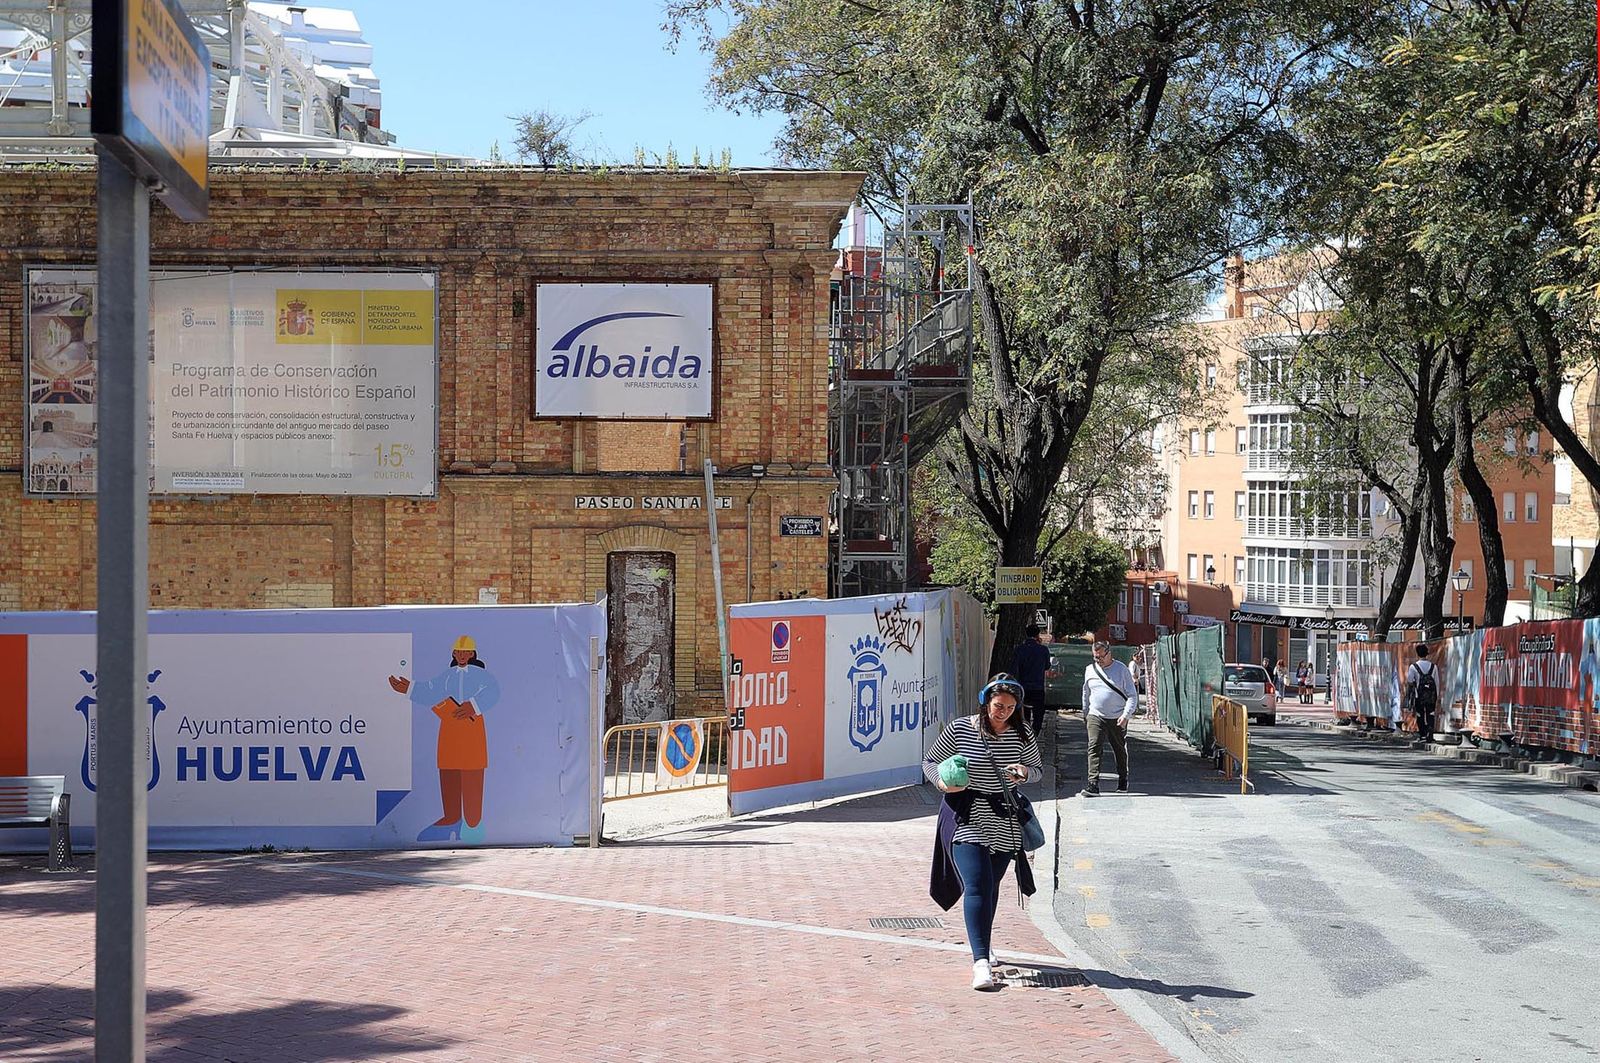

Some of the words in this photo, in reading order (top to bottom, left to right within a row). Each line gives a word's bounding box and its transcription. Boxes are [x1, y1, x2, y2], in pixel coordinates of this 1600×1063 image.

[547, 345, 701, 378] albaida
[172, 363, 246, 380] Programa
[250, 363, 269, 377] de
[274, 363, 378, 378] Conservación
[171, 383, 194, 398] del
[199, 383, 279, 398] Patrimonio
[284, 384, 350, 398] Histórico
[355, 385, 416, 402] Español
[172, 410, 203, 420] Proyecto
[205, 411, 215, 419] de
[216, 411, 268, 420] conservación,
[269, 411, 320, 420] consolidación
[364, 412, 409, 420] constructiva
[410, 413, 416, 422] y
[171, 421, 182, 429] de
[183, 421, 230, 429] urbanización
[231, 421, 275, 430] circundante
[276, 421, 288, 429] del
[289, 422, 317, 431] antiguo
[318, 422, 351, 430] mercado
[353, 422, 365, 430] del
[171, 431, 194, 439] Santa
[195, 431, 205, 440] Fe
[206, 431, 233, 440] Huelva
[234, 432, 240, 441] y
[241, 432, 274, 441] espacios
[275, 431, 306, 441] públicos
[374, 471, 415, 479] CULTURAL
[576, 497, 633, 509] PASEO
[643, 497, 700, 509] SANTA
[1000, 574, 1037, 583] ITINERARIO
[997, 587, 1040, 596] OBLIGATORIO
[177, 715, 333, 740] Ayuntamiento
[339, 714, 366, 734] de
[176, 746, 366, 781] HUELVA
